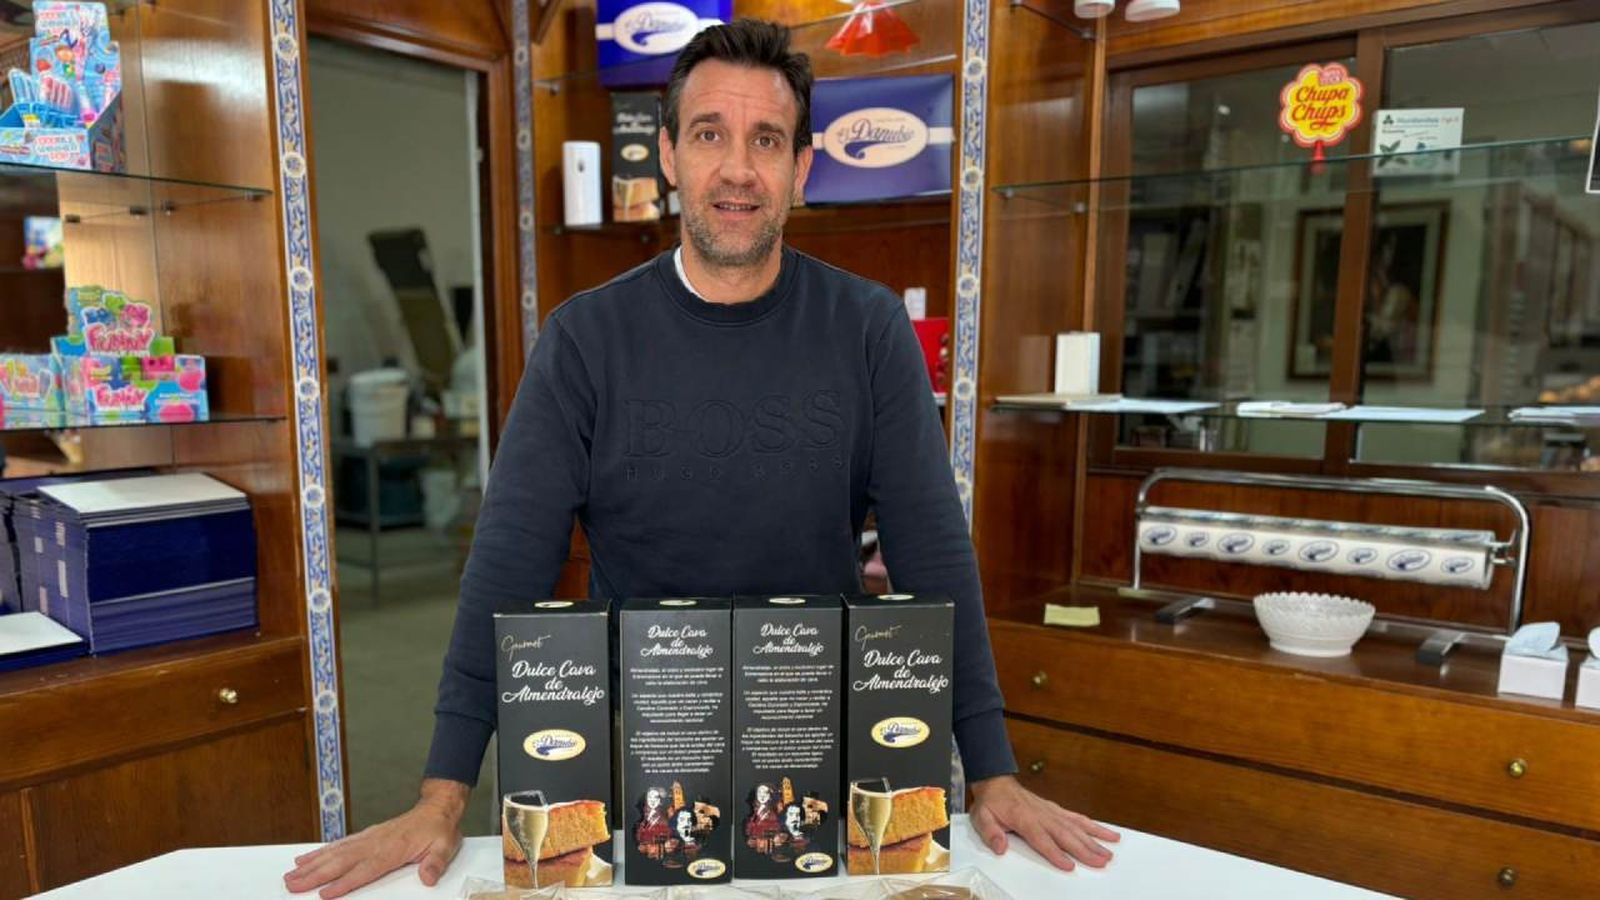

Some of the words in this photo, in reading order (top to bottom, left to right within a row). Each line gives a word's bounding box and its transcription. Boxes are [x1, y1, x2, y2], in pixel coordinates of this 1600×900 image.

[1295, 86, 1350, 105] Chupa
[1292, 102, 1347, 124] Chups
[622, 389, 845, 458] BOSS
[647, 625, 680, 639] Dulce
[681, 625, 708, 638] Cava
[760, 622, 791, 637] Dulce
[792, 622, 819, 637] Cava
[670, 637, 685, 648] de
[783, 635, 796, 646] de
[863, 649, 905, 668] Dulce
[907, 649, 942, 667] Cava
[511, 659, 556, 679] Dulce
[559, 659, 596, 678] Cava
[893, 665, 911, 679] de
[544, 675, 563, 691] de
[852, 673, 949, 694] Almendralejo
[501, 684, 605, 706] Almendralejo
